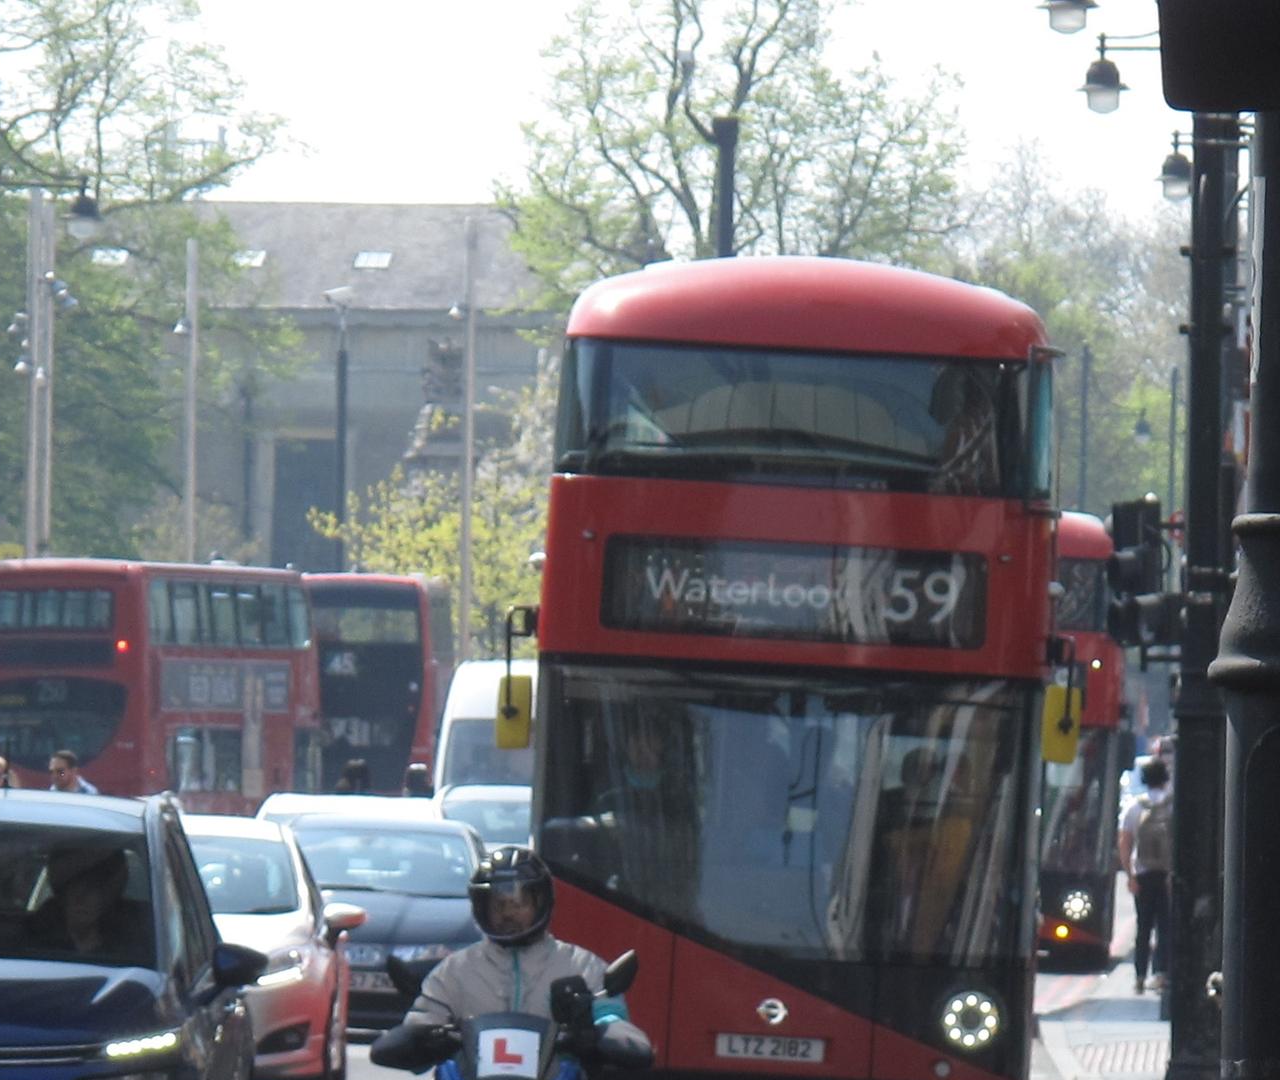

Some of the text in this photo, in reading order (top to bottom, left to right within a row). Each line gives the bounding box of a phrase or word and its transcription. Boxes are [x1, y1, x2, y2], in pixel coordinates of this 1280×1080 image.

[645, 566, 959, 625] Waterloo 59
[494, 1038, 523, 1064] L
[727, 1035, 812, 1058] LTZ 2182
